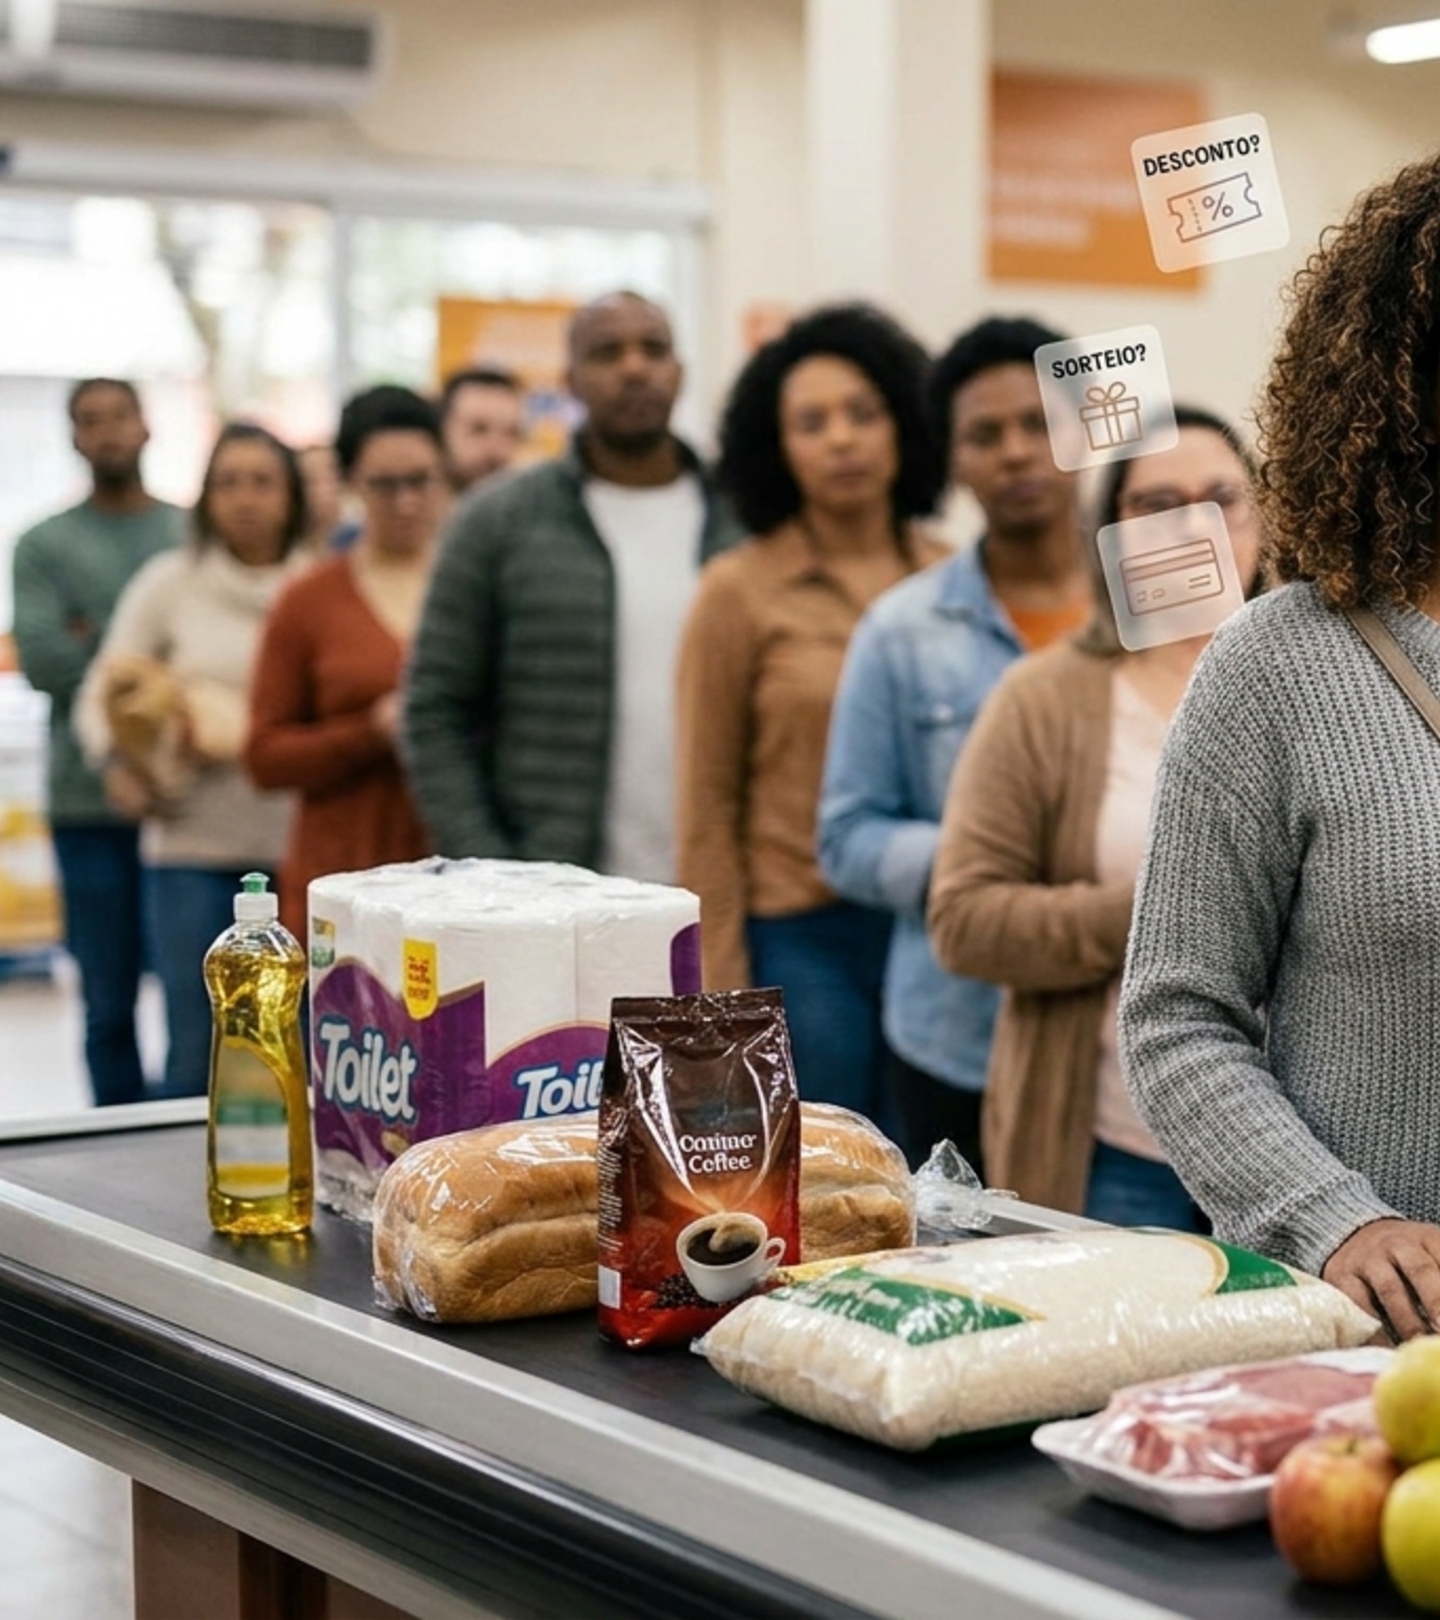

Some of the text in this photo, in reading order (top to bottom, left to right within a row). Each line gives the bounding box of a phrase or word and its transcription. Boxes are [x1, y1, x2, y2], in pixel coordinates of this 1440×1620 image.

[320, 1022, 417, 1119] Toilet
[517, 1060, 604, 1118] Toil
[688, 1151, 752, 1174] Coffee
